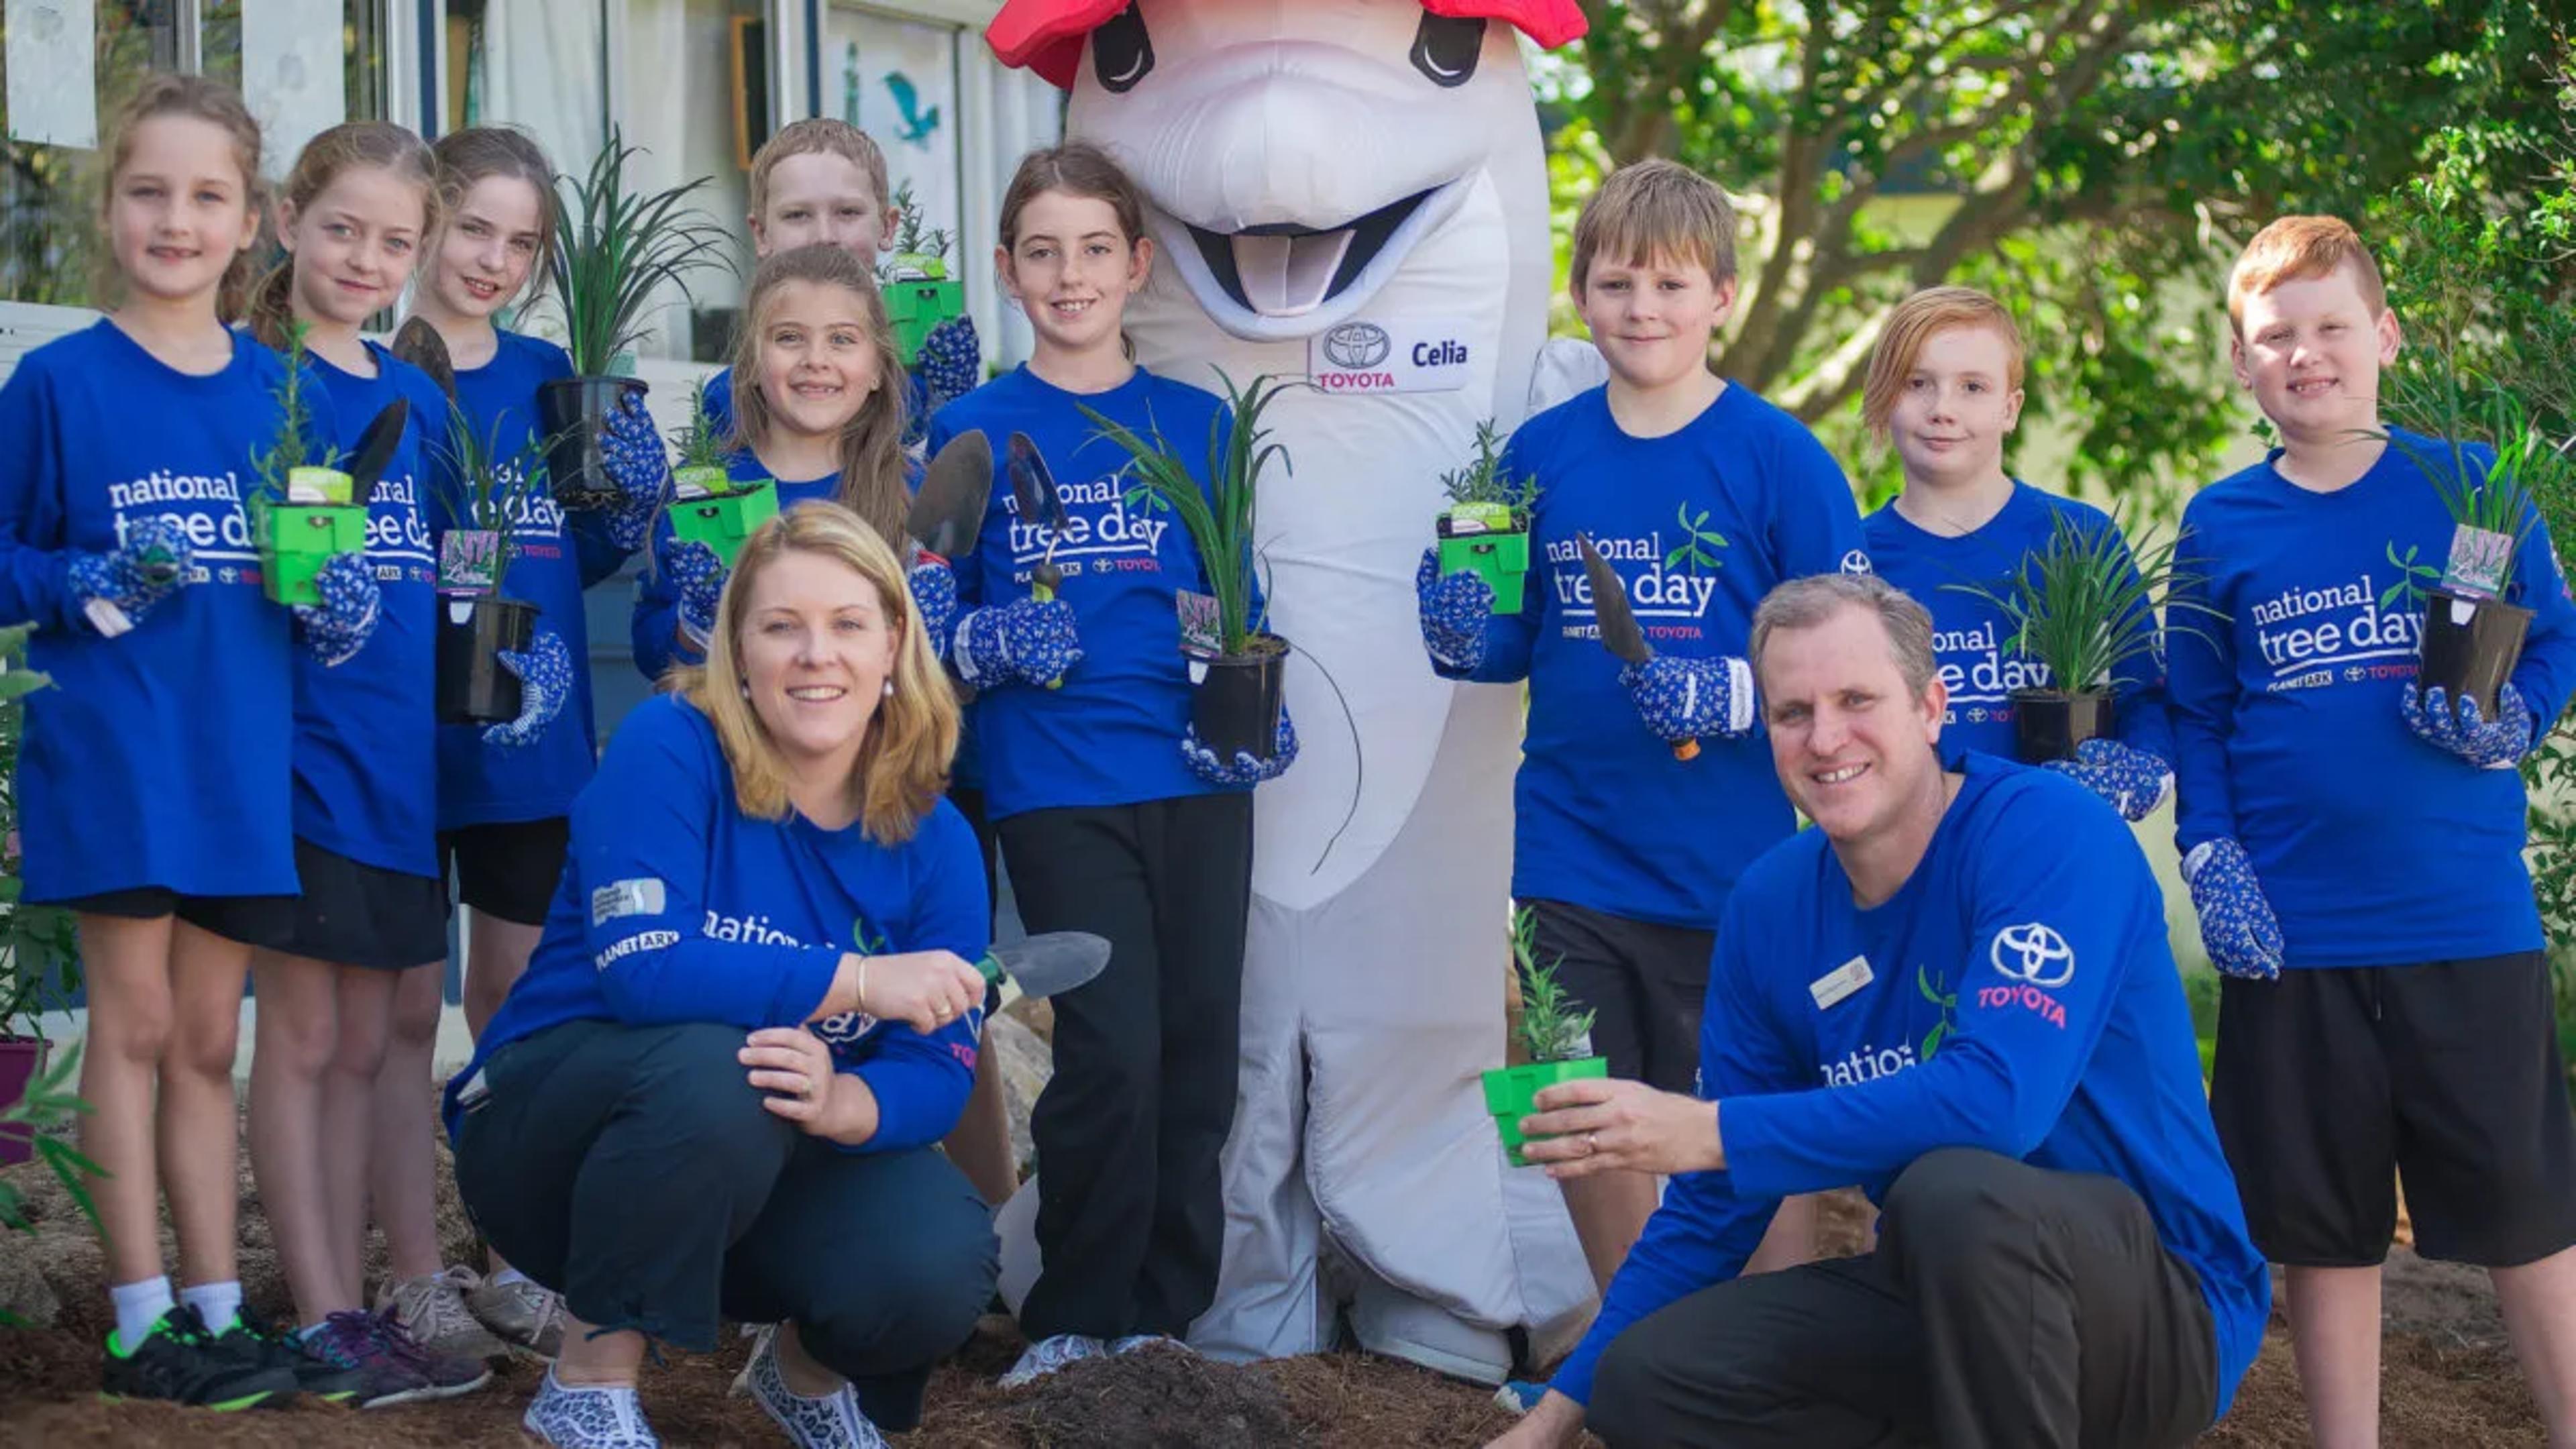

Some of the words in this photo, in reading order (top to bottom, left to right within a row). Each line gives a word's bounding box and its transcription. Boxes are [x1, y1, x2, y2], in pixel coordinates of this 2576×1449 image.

[1412, 339, 1468, 366] Celia
[1319, 373, 1395, 388] TOYOTA
[108, 470, 240, 508] national
[1002, 474, 1122, 515] nonal
[1097, 500, 1169, 556] day
[1633, 562, 1716, 618] day
[2251, 574, 2375, 626] national
[1648, 626, 1703, 639] TOYOTA
[1931, 621, 1997, 653] onal
[2259, 623, 2341, 666] tree
[1978, 983, 2066, 1029] TOYOTA
